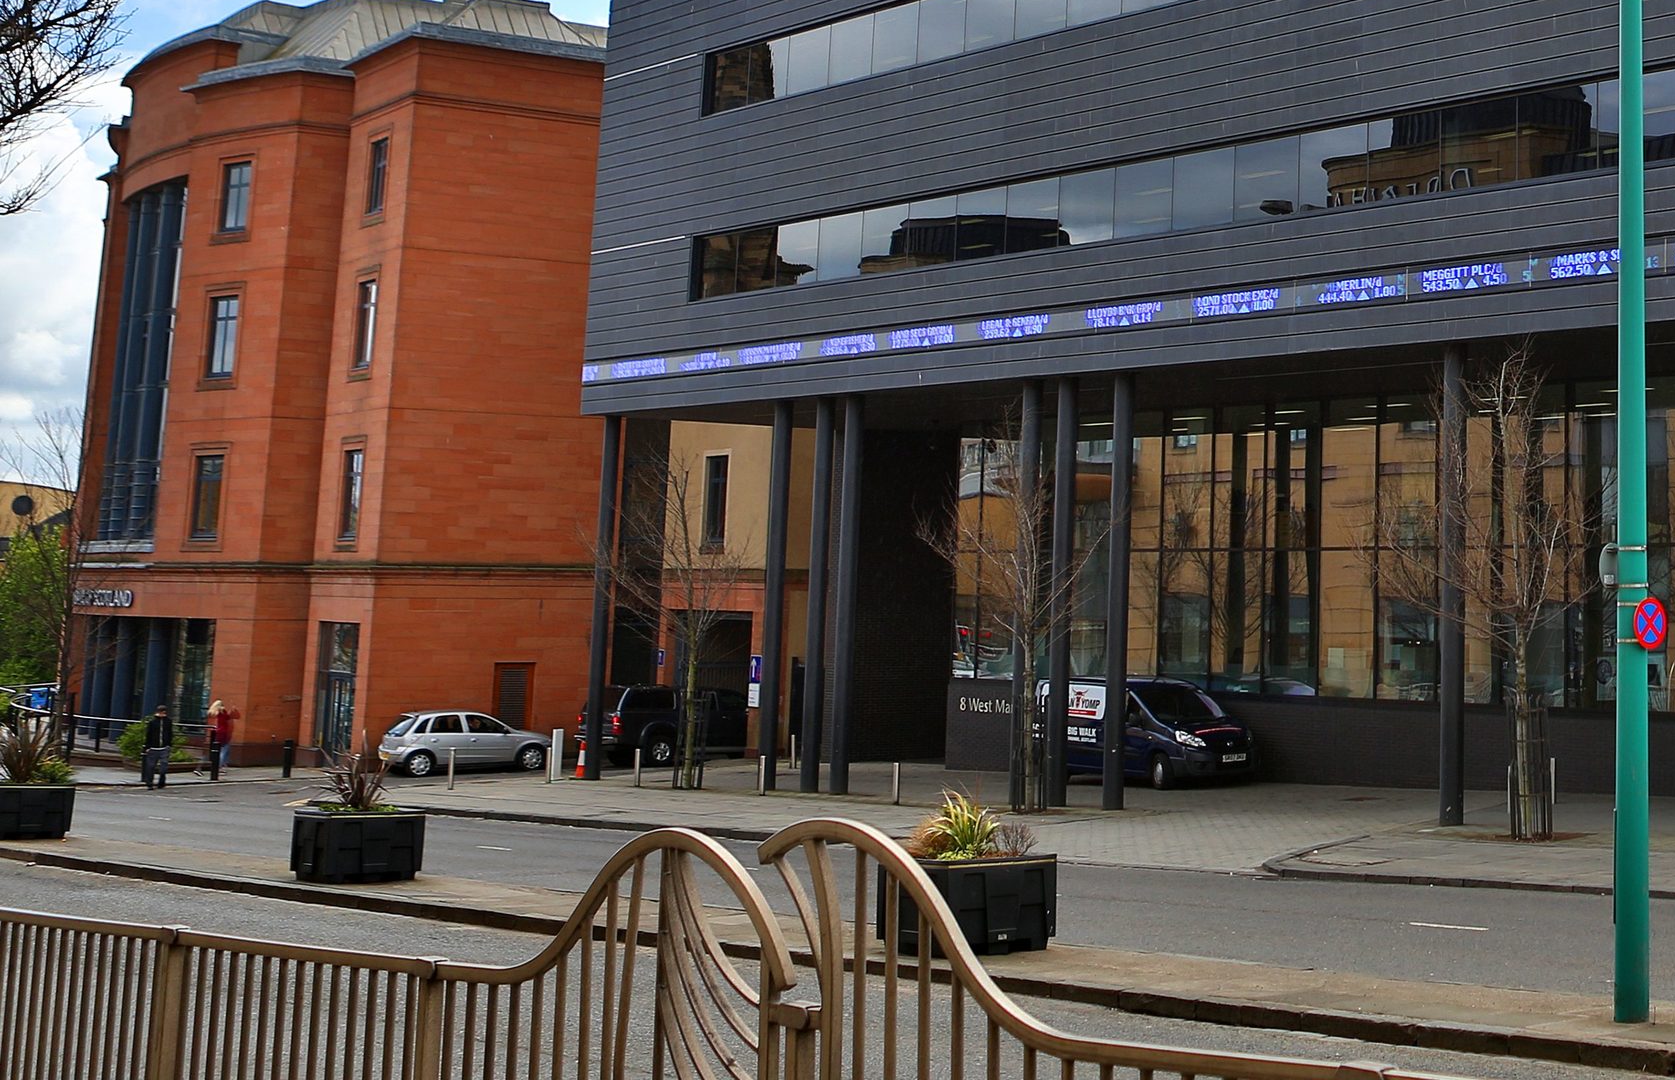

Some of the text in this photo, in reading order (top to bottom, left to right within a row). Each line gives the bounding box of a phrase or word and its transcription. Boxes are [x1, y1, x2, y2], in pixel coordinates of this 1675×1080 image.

[1556, 251, 1597, 267] MARKS
[1598, 250, 1609, 262] &
[1422, 263, 1503, 281] MEGGITT PLC/d
[1550, 264, 1591, 279] 562.50
[1336, 276, 1383, 291] MERLIN/d
[1422, 273, 1508, 293] 543.50 4.50
[1197, 288, 1279, 307] LOND STOCK EXC/d
[1318, 285, 1396, 304] 444.40 1.00
[959, 696, 967, 712] 8
[968, 697, 993, 713] West
[1078, 726, 1097, 738] WALK
